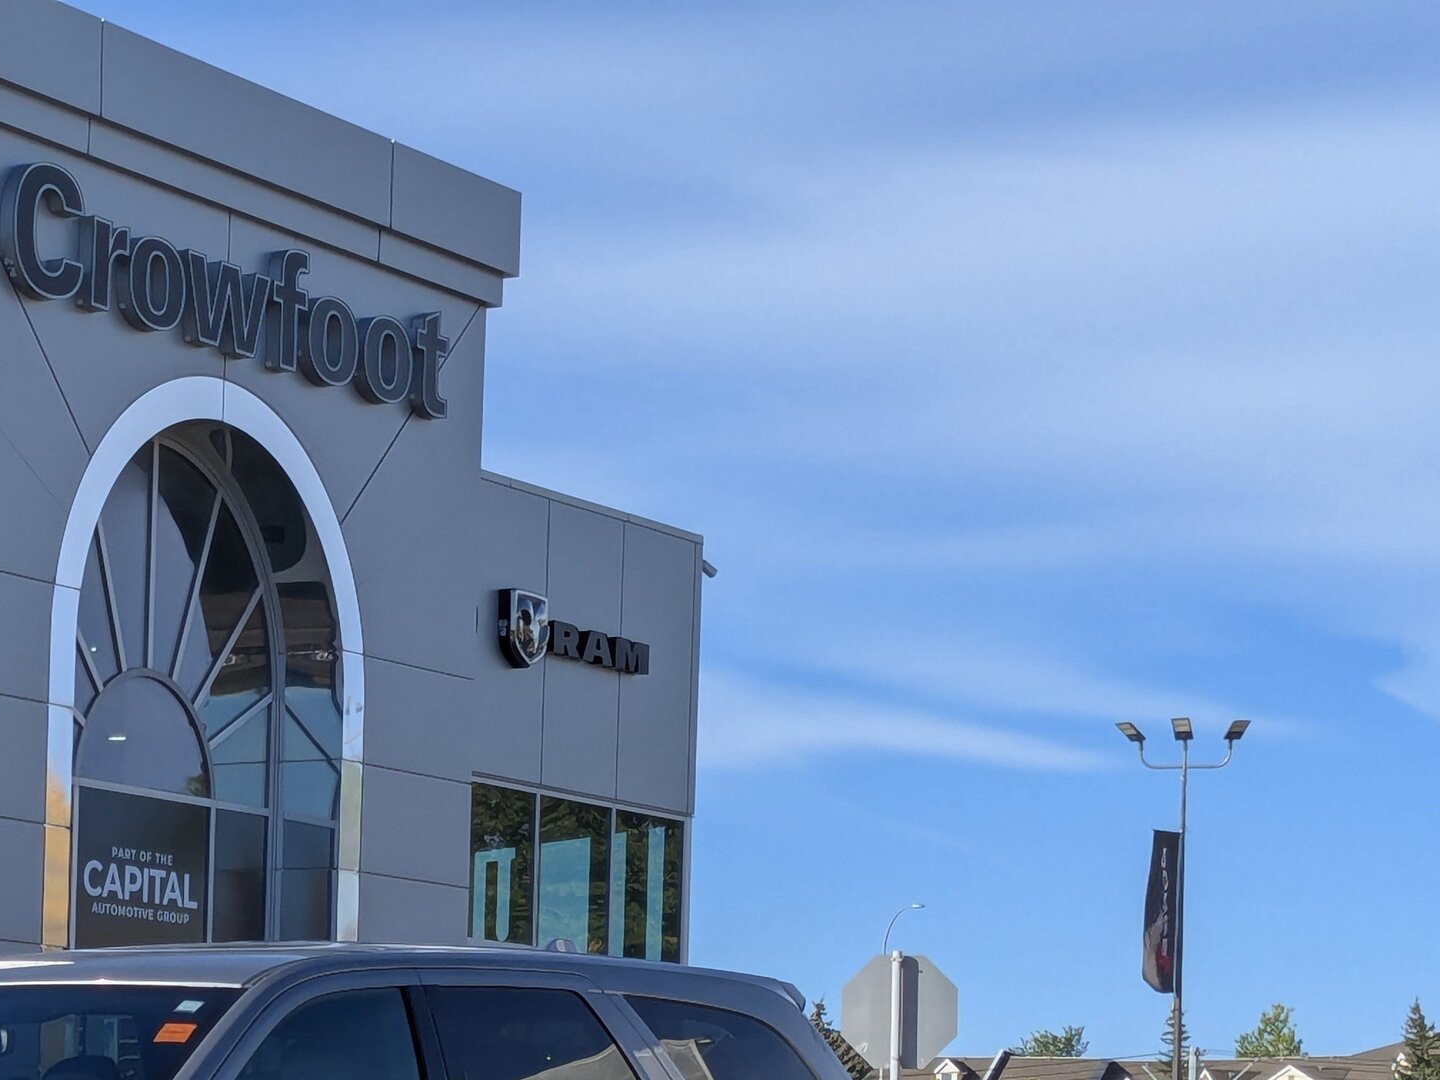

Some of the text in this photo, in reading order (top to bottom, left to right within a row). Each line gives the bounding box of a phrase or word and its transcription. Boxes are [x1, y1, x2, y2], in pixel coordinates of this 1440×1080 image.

[2, 161, 449, 420] Crowfoot
[549, 620, 650, 676] RAM
[112, 847, 173, 865] PART OF THE
[83, 859, 198, 909] CAPITAL
[92, 902, 190, 924] AUTOMOTIVE GROUP
